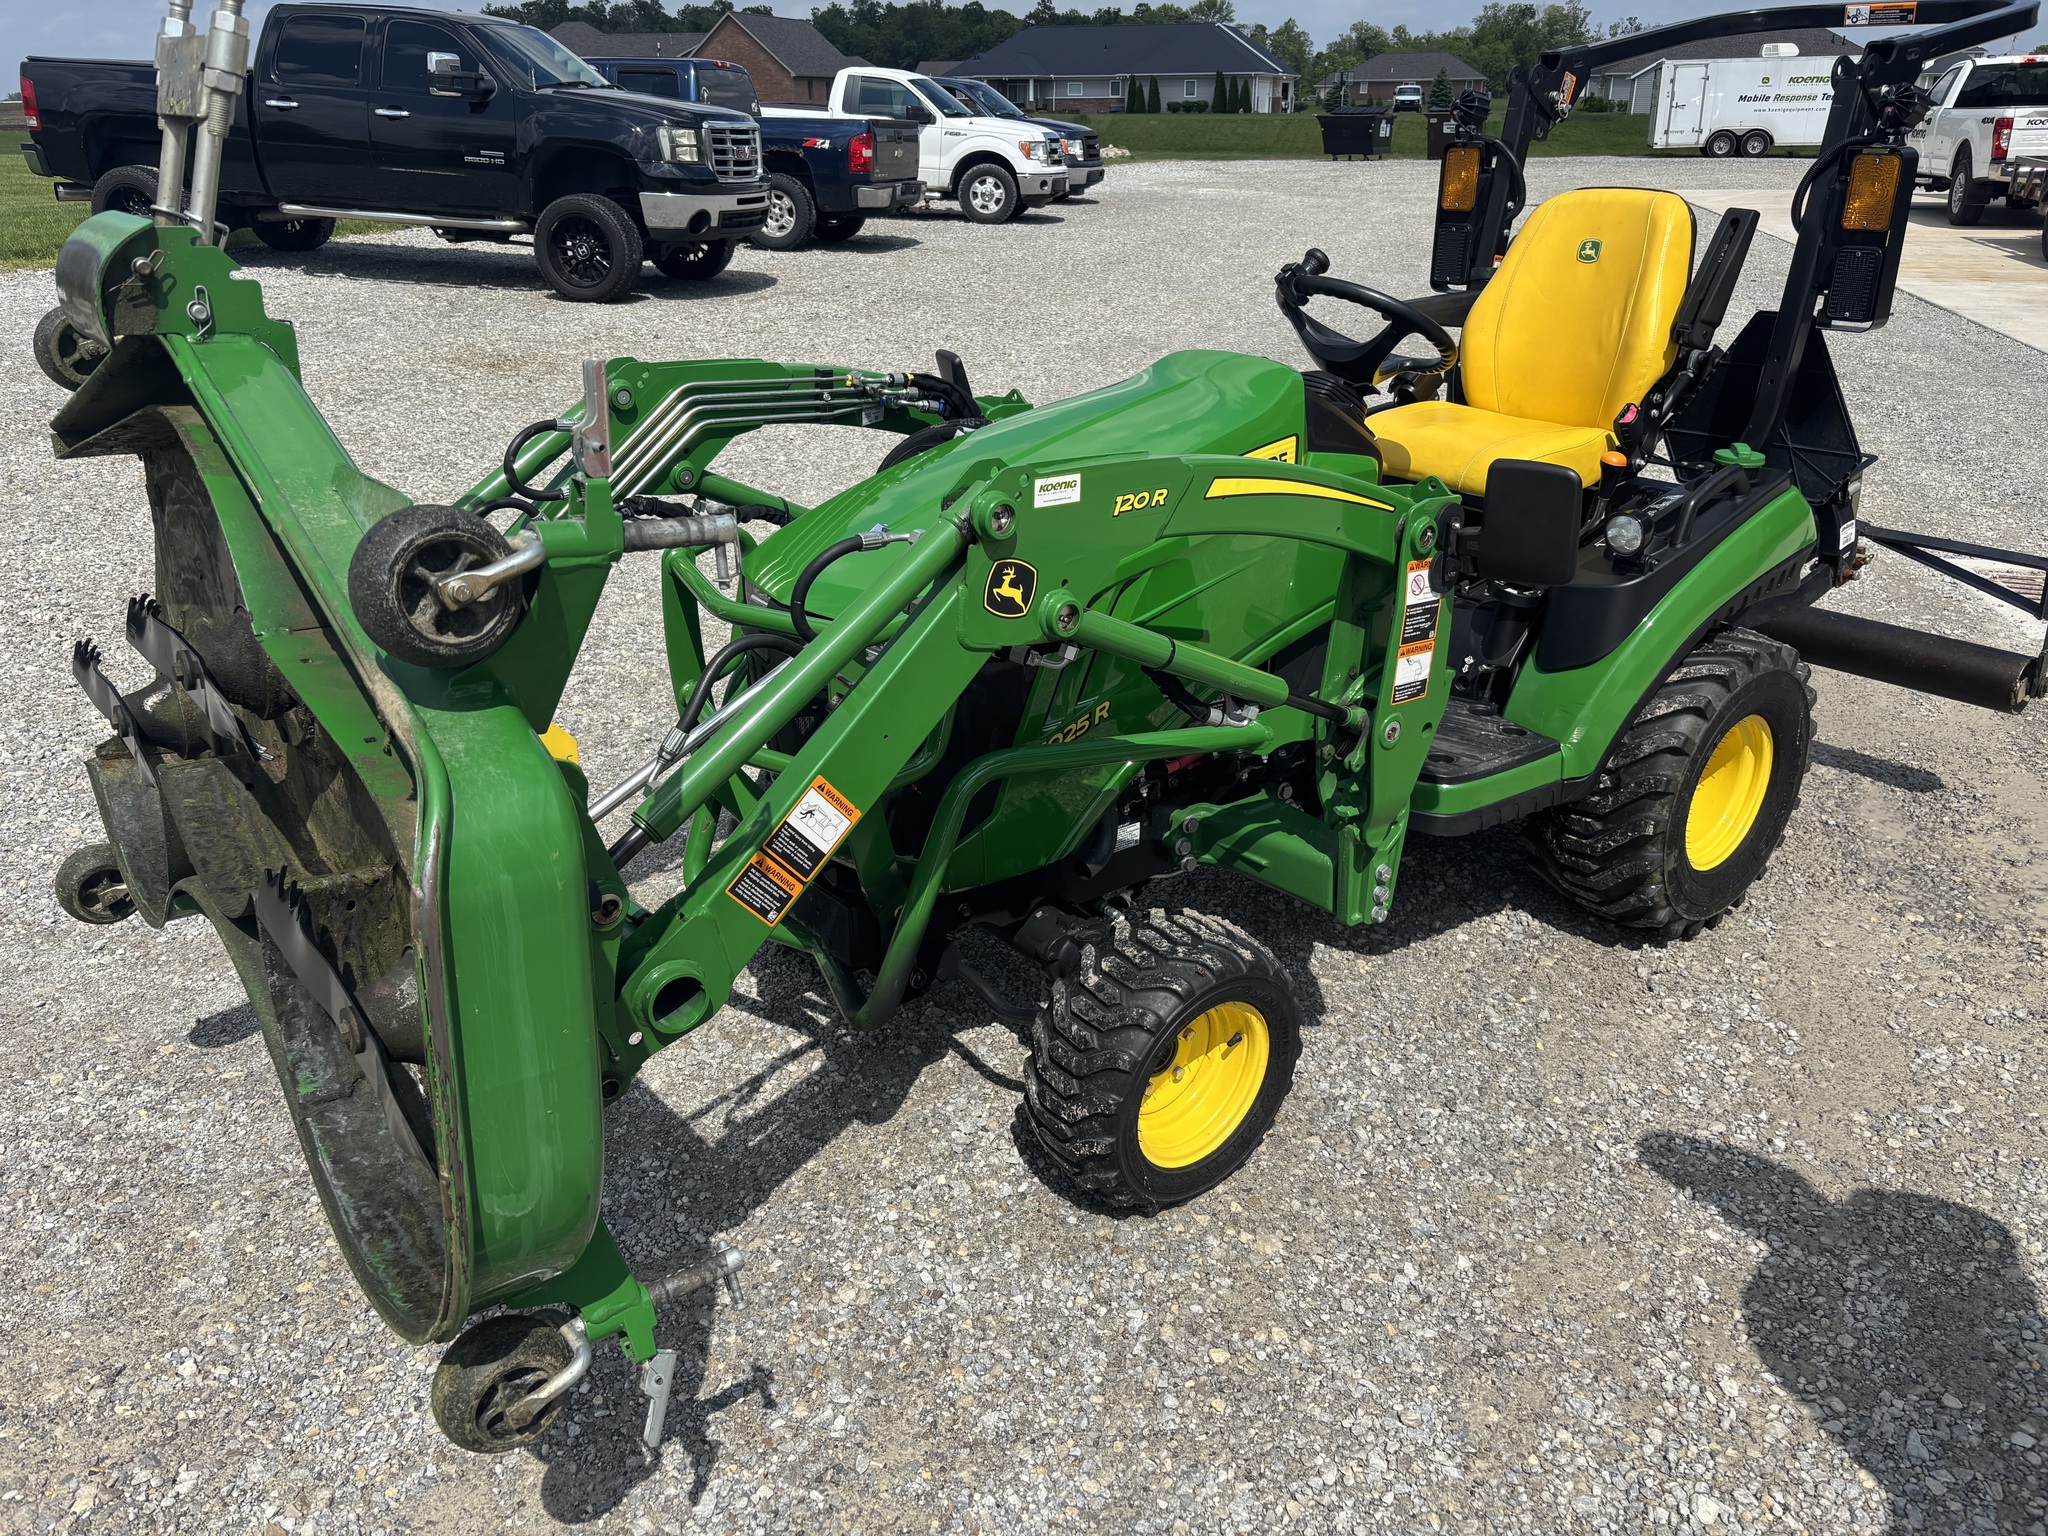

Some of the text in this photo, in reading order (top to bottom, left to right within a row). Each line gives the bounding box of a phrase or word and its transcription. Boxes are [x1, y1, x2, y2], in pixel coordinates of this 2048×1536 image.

[1738, 94, 1771, 103] Mobile
[1773, 93, 1818, 103] Response
[1113, 488, 1169, 517] 120 R
[1405, 642, 1433, 654] WARNING
[1094, 700, 1111, 726] R
[825, 788, 855, 817] WARNING
[765, 863, 796, 892] WARNING
